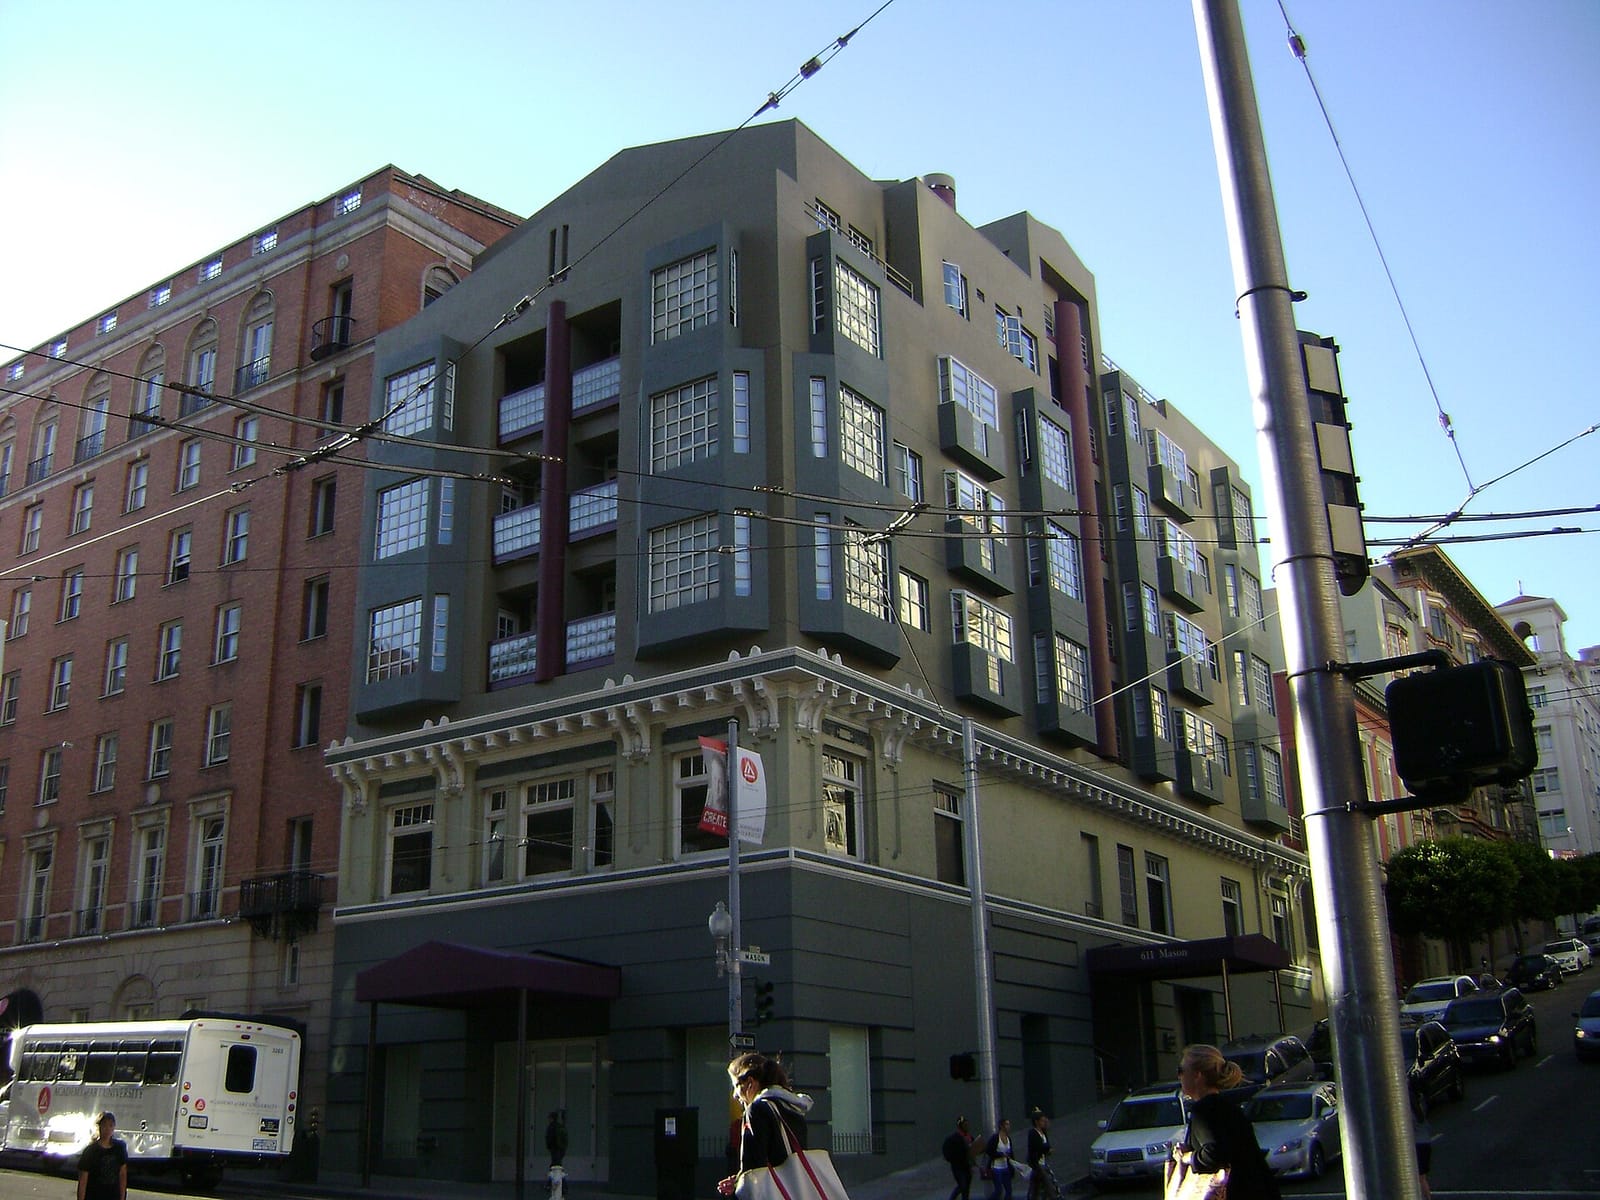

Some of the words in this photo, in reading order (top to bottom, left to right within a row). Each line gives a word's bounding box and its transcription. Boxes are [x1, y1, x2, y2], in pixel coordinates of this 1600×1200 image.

[703, 810, 727, 828] CREATE
[745, 953, 765, 962] MASON
[1140, 950, 1154, 960] 611
[1159, 948, 1188, 959] Mason
[103, 1087, 143, 1099] UNIVERSITY
